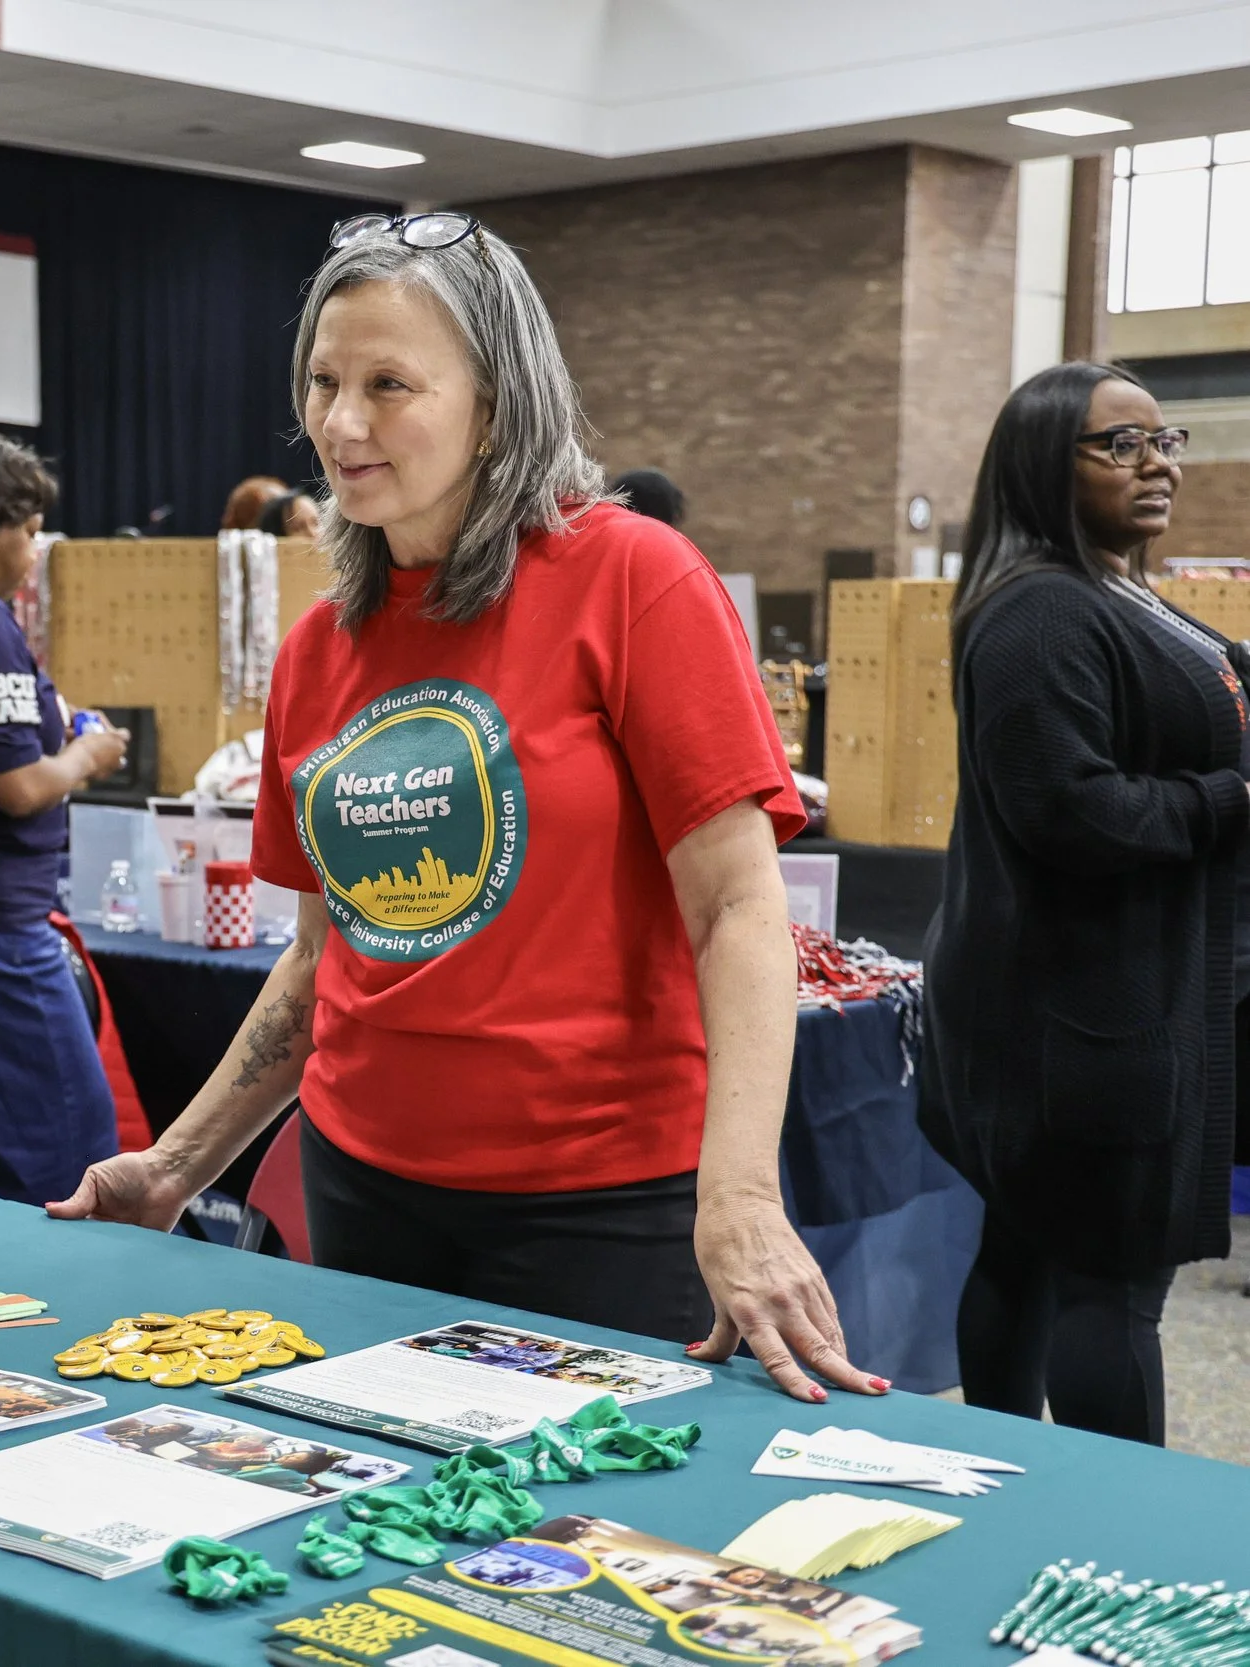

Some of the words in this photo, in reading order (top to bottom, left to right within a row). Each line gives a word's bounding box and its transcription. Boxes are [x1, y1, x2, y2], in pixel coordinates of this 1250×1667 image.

[299, 718, 368, 779] Michigan
[371, 686, 448, 719] Education
[449, 689, 501, 755] Association
[334, 770, 398, 797] Next
[403, 765, 454, 791] Gen
[335, 795, 451, 826] Teachers
[297, 814, 324, 876] Wayne
[362, 828, 392, 838] Summer
[394, 825, 429, 836] Program
[489, 789, 516, 890] Education
[375, 892, 415, 904] Preparing
[418, 892, 427, 900] to
[428, 890, 450, 899] Make
[391, 904, 439, 914] Difference!
[483, 889, 497, 911] of
[350, 916, 415, 955] University
[420, 910, 481, 949] College
[260, 1387, 320, 1405] WARRIOR
[319, 1402, 376, 1419] STRONG
[298, 1406, 355, 1422] STRONG
[807, 1452, 852, 1467] WAYNE
[853, 1461, 895, 1474] STATE
